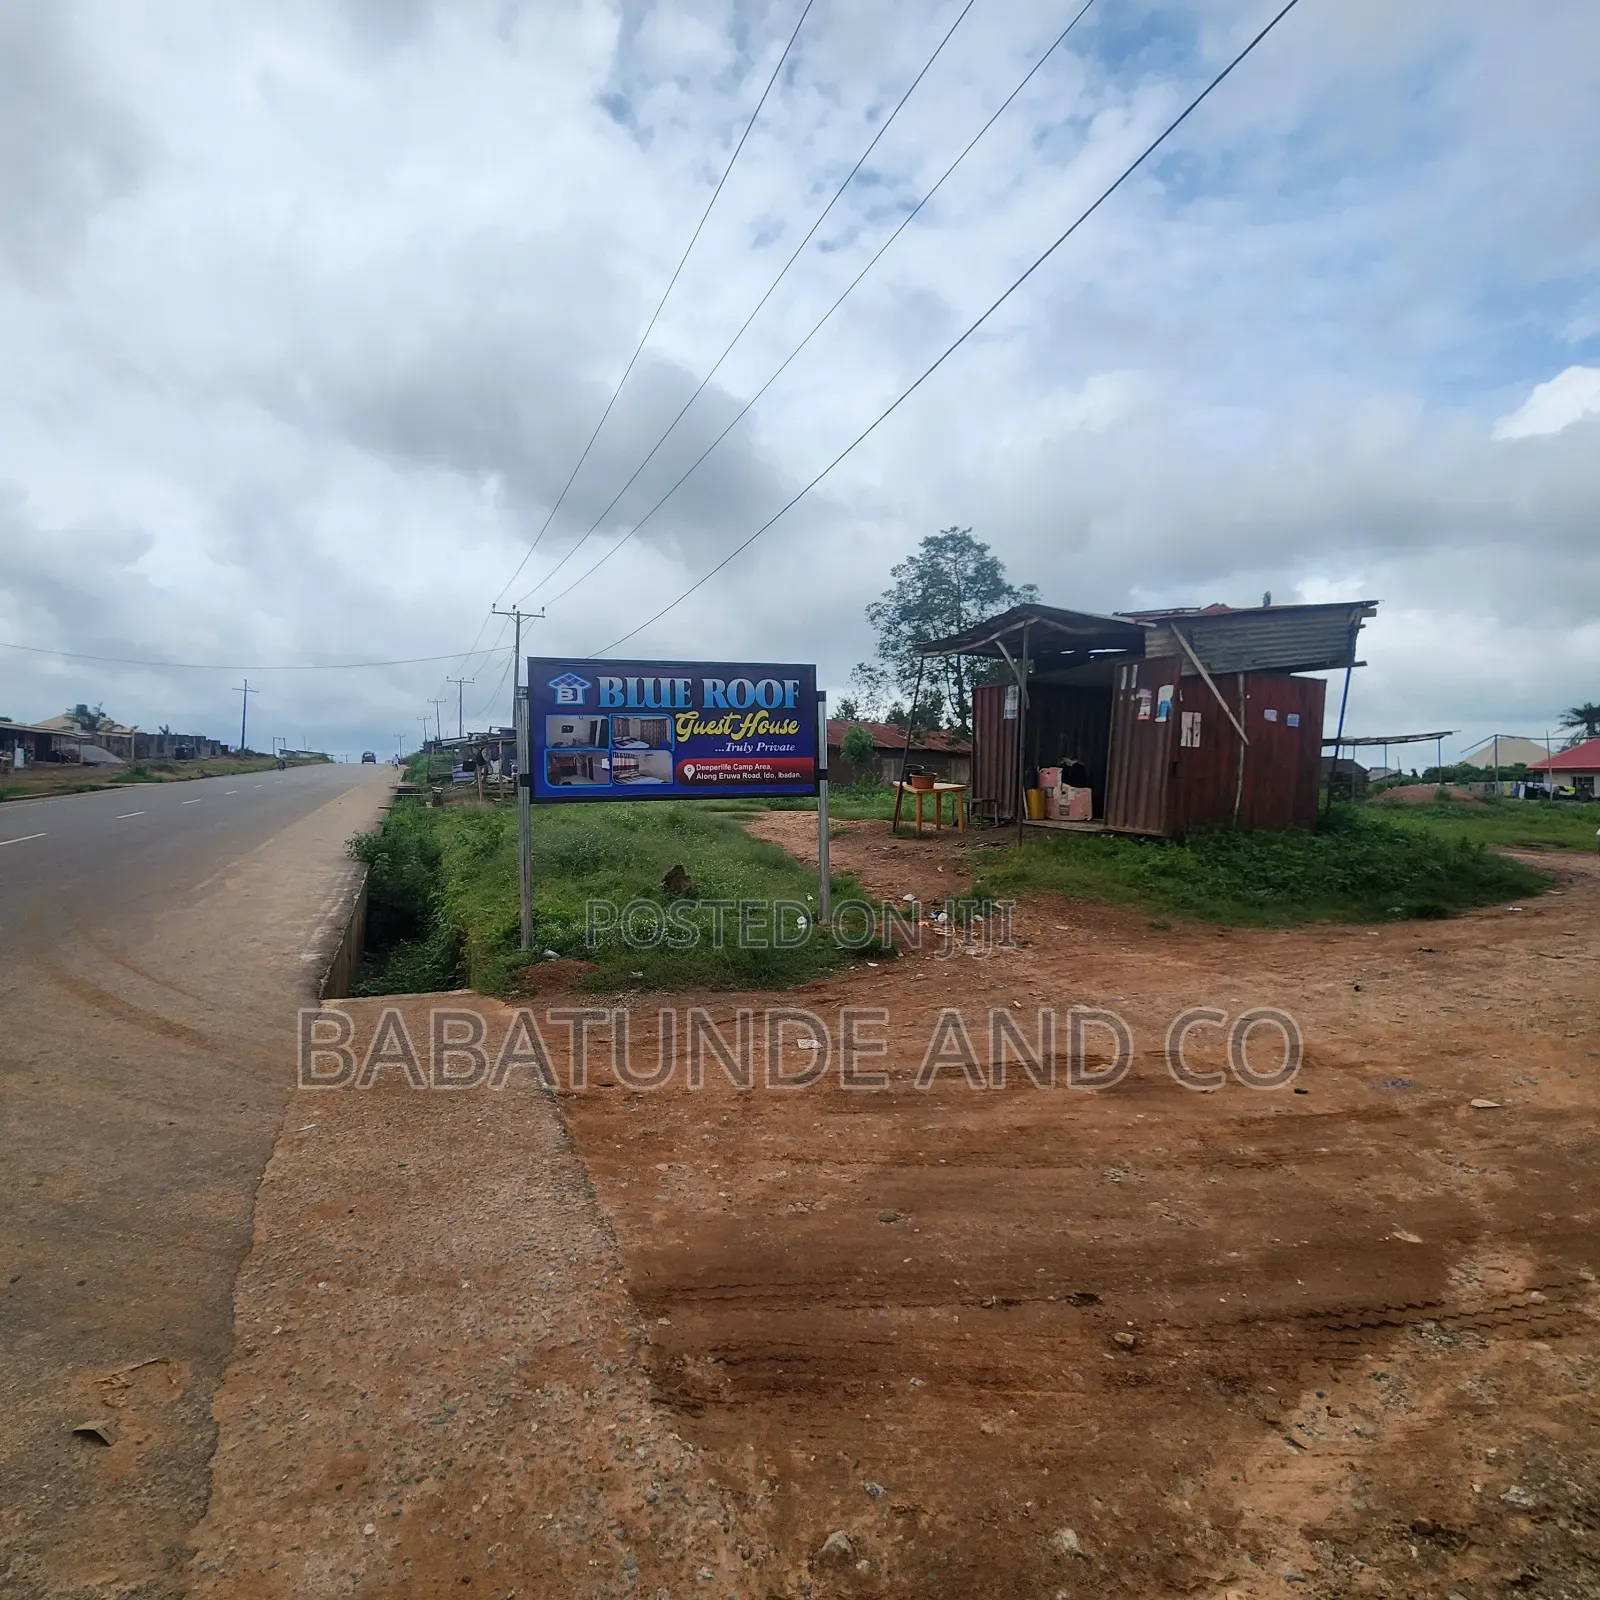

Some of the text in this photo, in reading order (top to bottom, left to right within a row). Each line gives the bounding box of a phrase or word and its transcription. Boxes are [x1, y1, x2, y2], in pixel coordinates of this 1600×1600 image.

[597, 676, 800, 709] BLUE ROOF
[675, 710, 800, 742] Guest House
[756, 742, 796, 752] Private
[733, 764, 753, 772] Camp
[696, 772, 717, 781] Along
[719, 772, 741, 780] Eruwa
